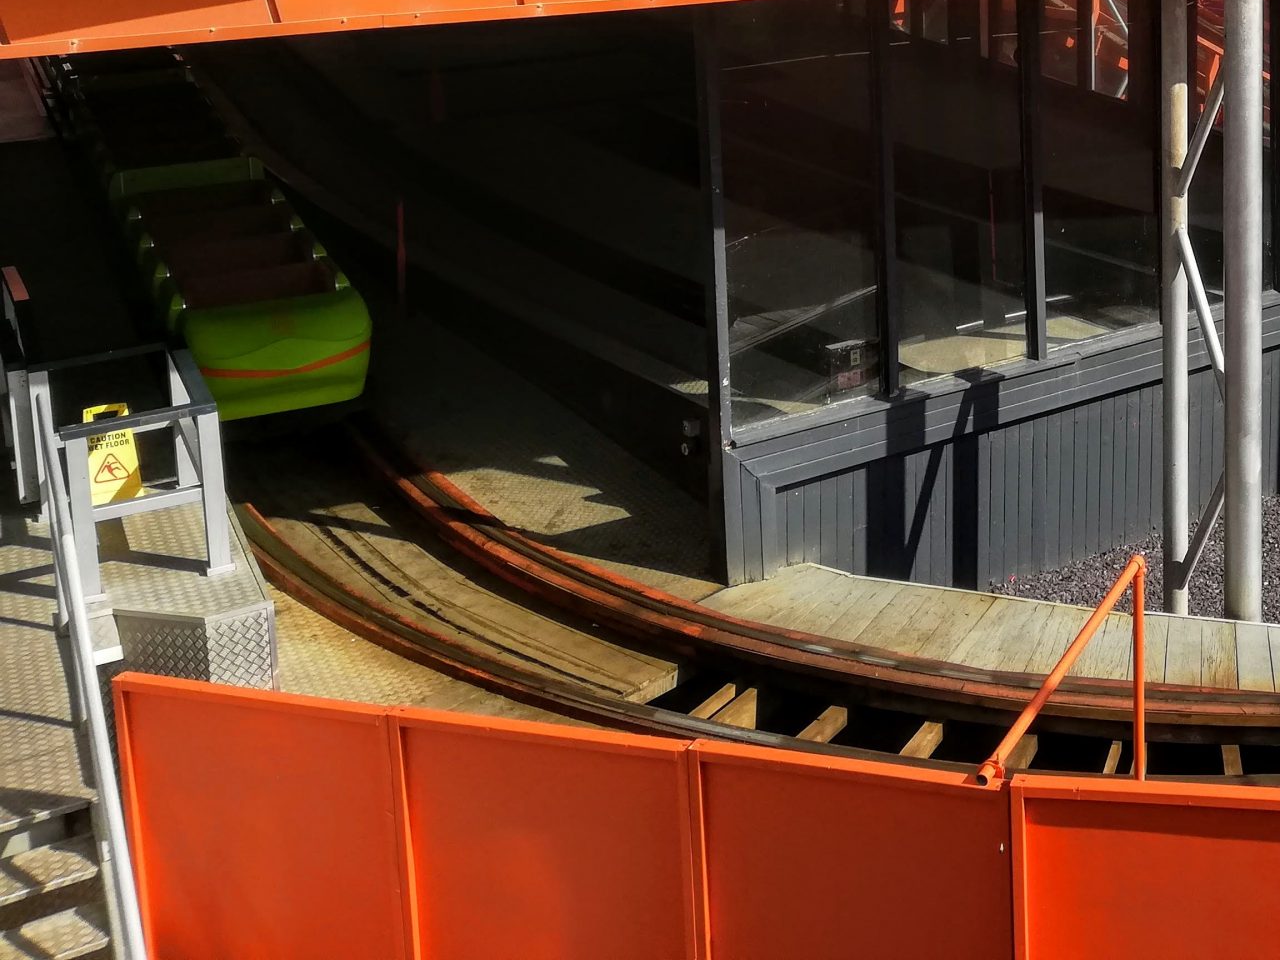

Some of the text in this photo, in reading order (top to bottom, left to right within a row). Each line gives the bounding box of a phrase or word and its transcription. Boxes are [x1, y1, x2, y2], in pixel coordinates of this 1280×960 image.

[90, 432, 126, 444] CAUTION
[88, 439, 130, 452] WET FLOOR
